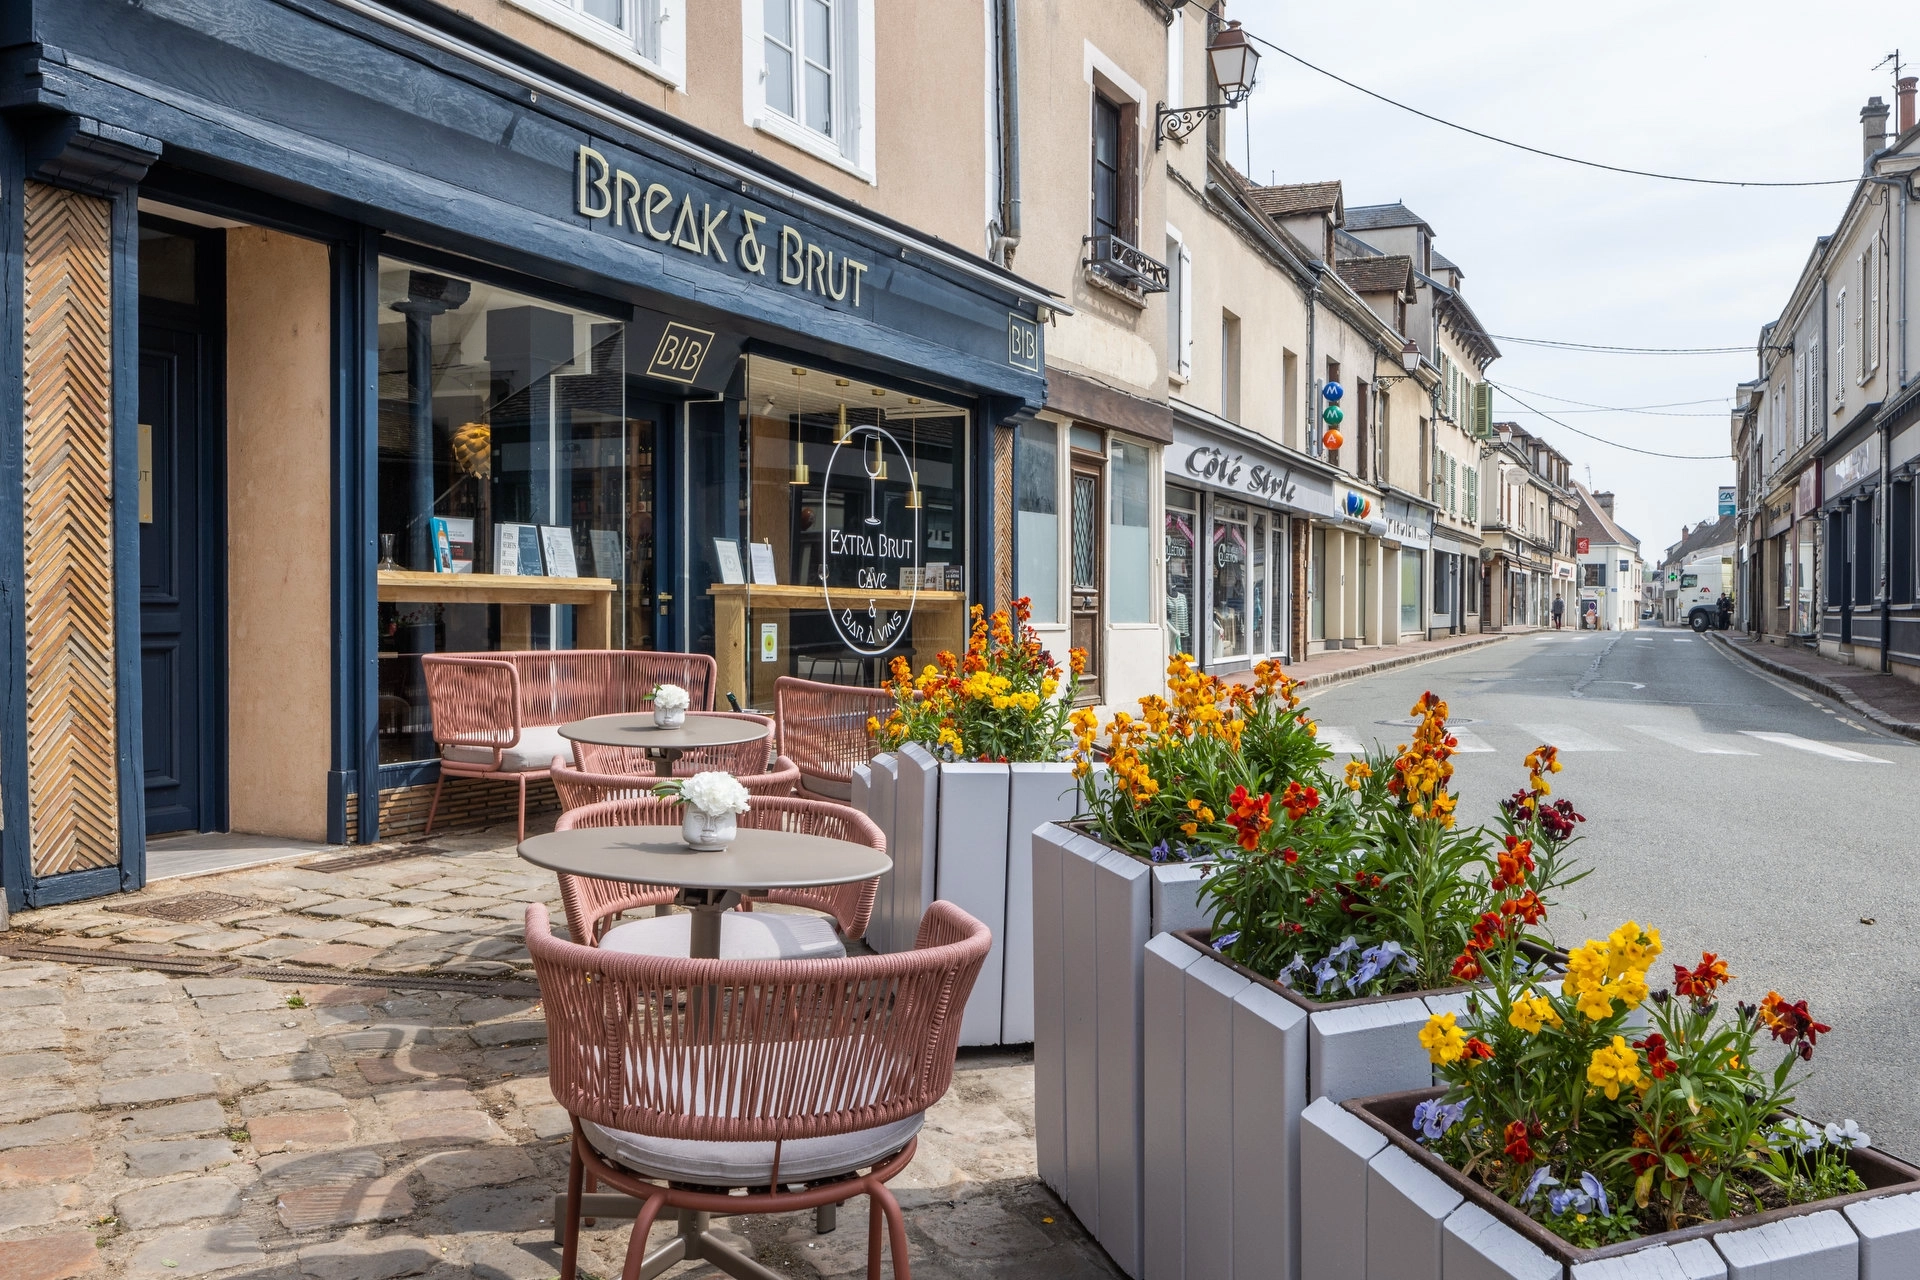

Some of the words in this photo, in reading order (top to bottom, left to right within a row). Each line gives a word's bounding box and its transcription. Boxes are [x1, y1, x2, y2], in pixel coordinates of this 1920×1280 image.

[740, 210, 767, 275] &
[1185, 446, 1243, 486] Côté
[1247, 464, 1297, 502] Style
[868, 599, 877, 618] &
